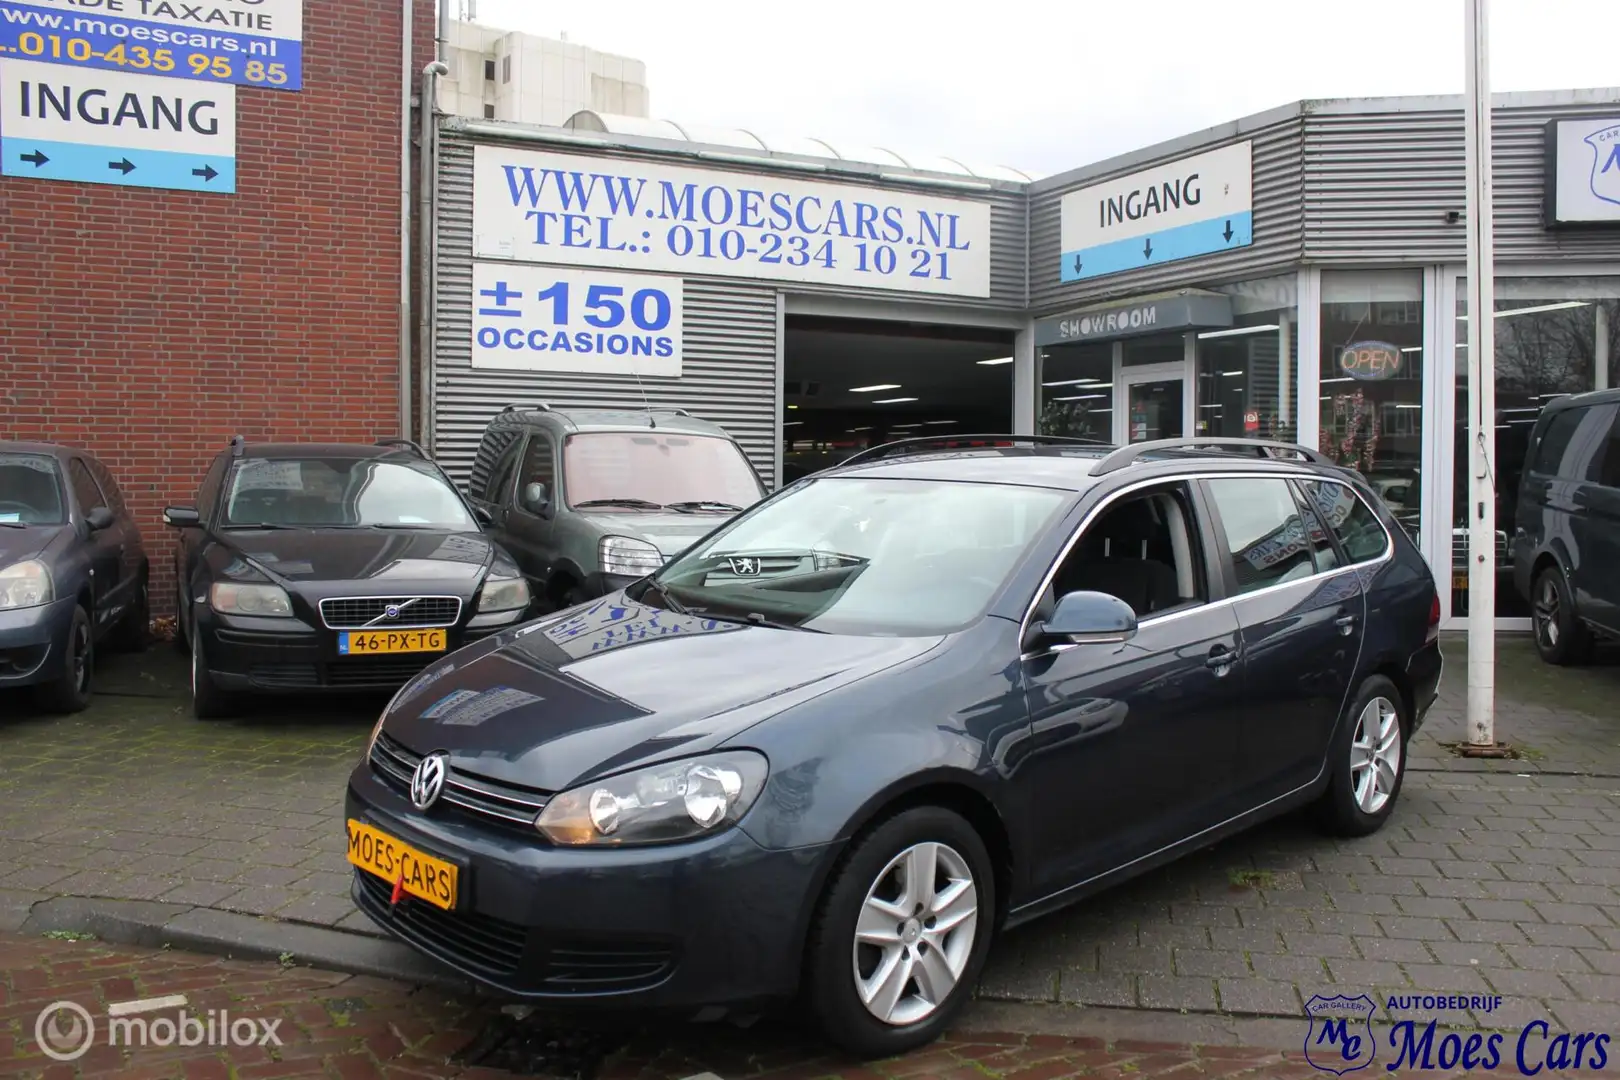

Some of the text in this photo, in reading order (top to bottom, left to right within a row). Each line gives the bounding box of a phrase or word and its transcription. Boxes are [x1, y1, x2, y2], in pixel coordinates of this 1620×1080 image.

[137, 0, 272, 31] TAXATIE
[187, 53, 232, 78] 95
[245, 60, 288, 84] 85
[20, 80, 219, 136] INGANG
[501, 165, 971, 251] WWW.MOESCARS.NL
[1100, 174, 1201, 228] INGANG
[524, 210, 953, 281] TEL.: 010-234 10 21
[538, 281, 672, 332] 150
[1059, 306, 1157, 338] SHOWROOM
[477, 327, 674, 357] OCCASIONS
[1341, 349, 1400, 372] OPEN
[355, 632, 441, 651] 46-PX-TG
[348, 828, 451, 903] MOES-CARS
